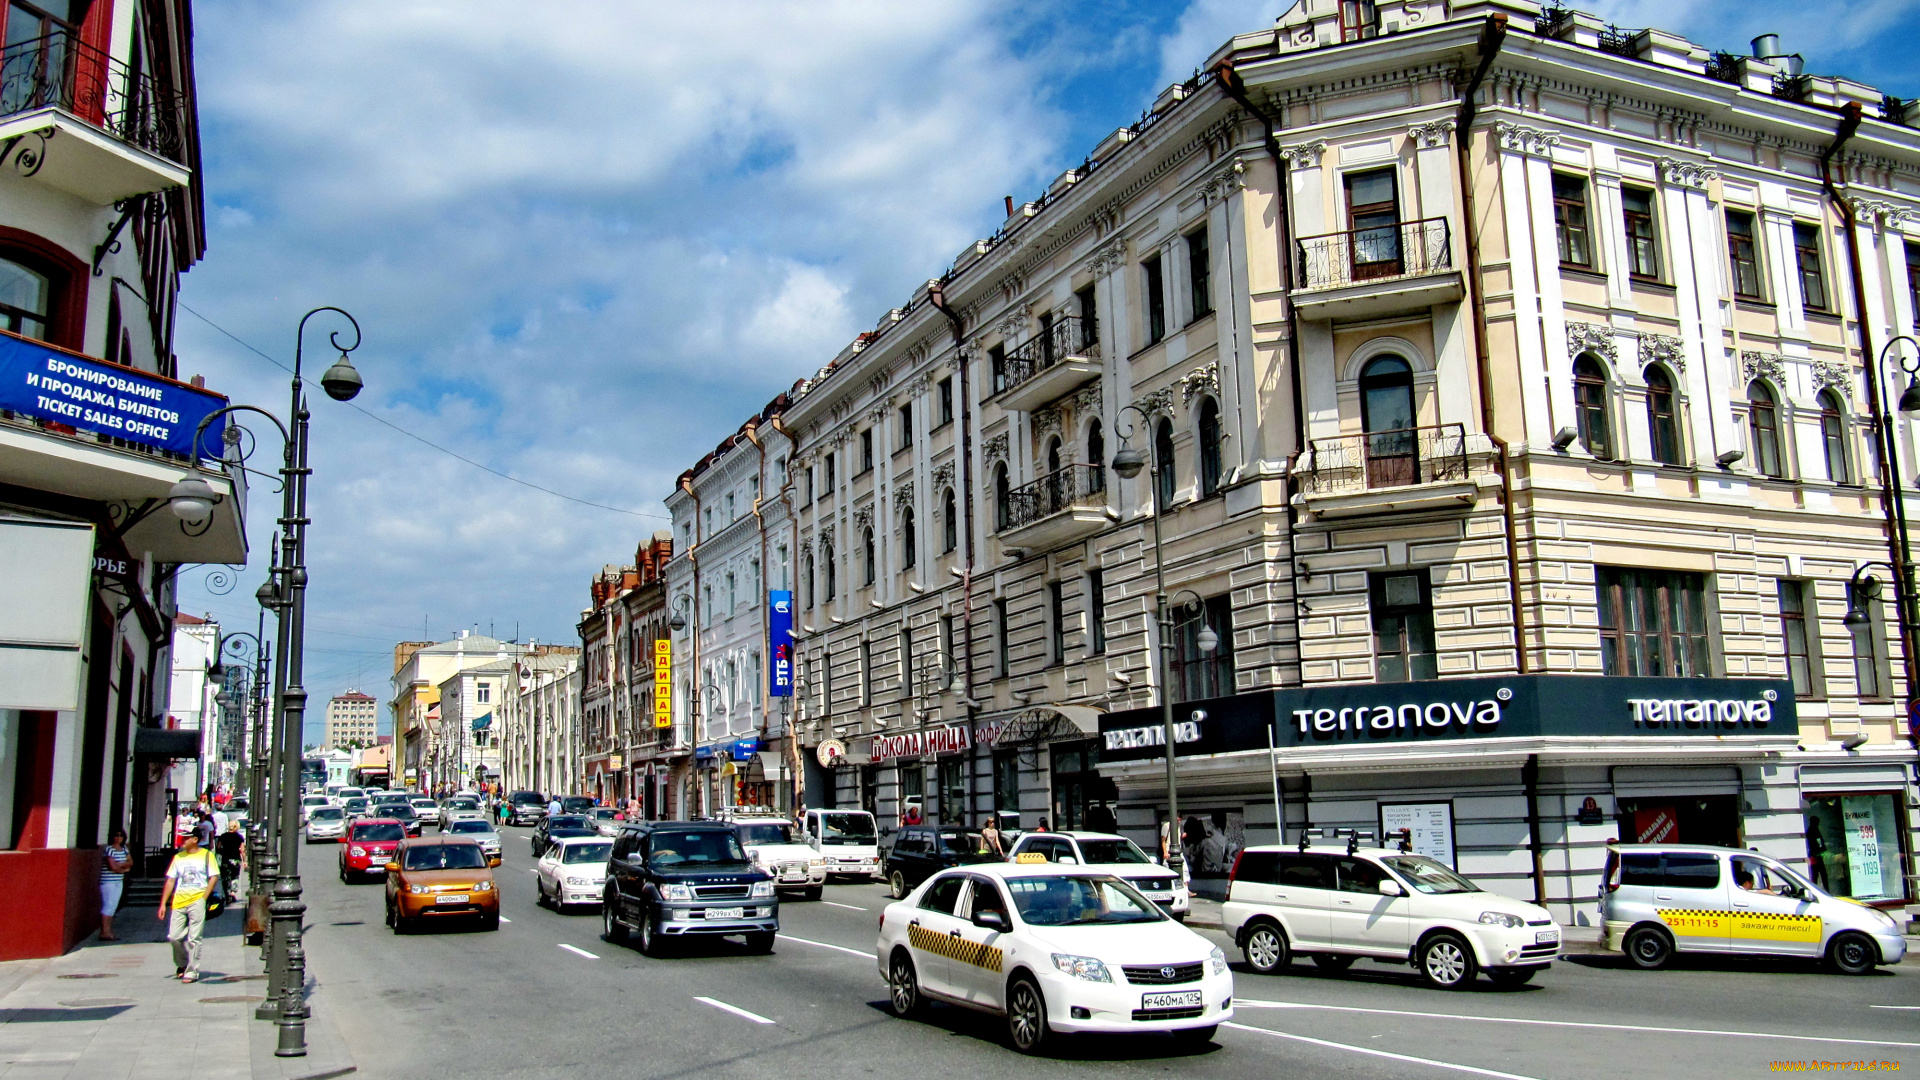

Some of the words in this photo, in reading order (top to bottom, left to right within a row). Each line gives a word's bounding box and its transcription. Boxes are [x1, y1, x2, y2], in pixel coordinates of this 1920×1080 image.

[47, 358, 162, 401] БРОНИРОВАНИЕ
[26, 372, 39, 387] И
[41, 376, 115, 409] ПРОДАЖА
[118, 398, 179, 424] БИЛЕТОВ
[37, 396, 83, 419] TICKET
[83, 408, 123, 429] SALES
[125, 419, 169, 440] OFFICE
[1860, 825, 1874, 839] 599
[1862, 843, 1877, 857] 799
[1862, 861, 1879, 876] 1199
[1740, 922, 1775, 931] закажи
[1777, 922, 1811, 933] такси!
[1186, 993, 1199, 1004] 125
